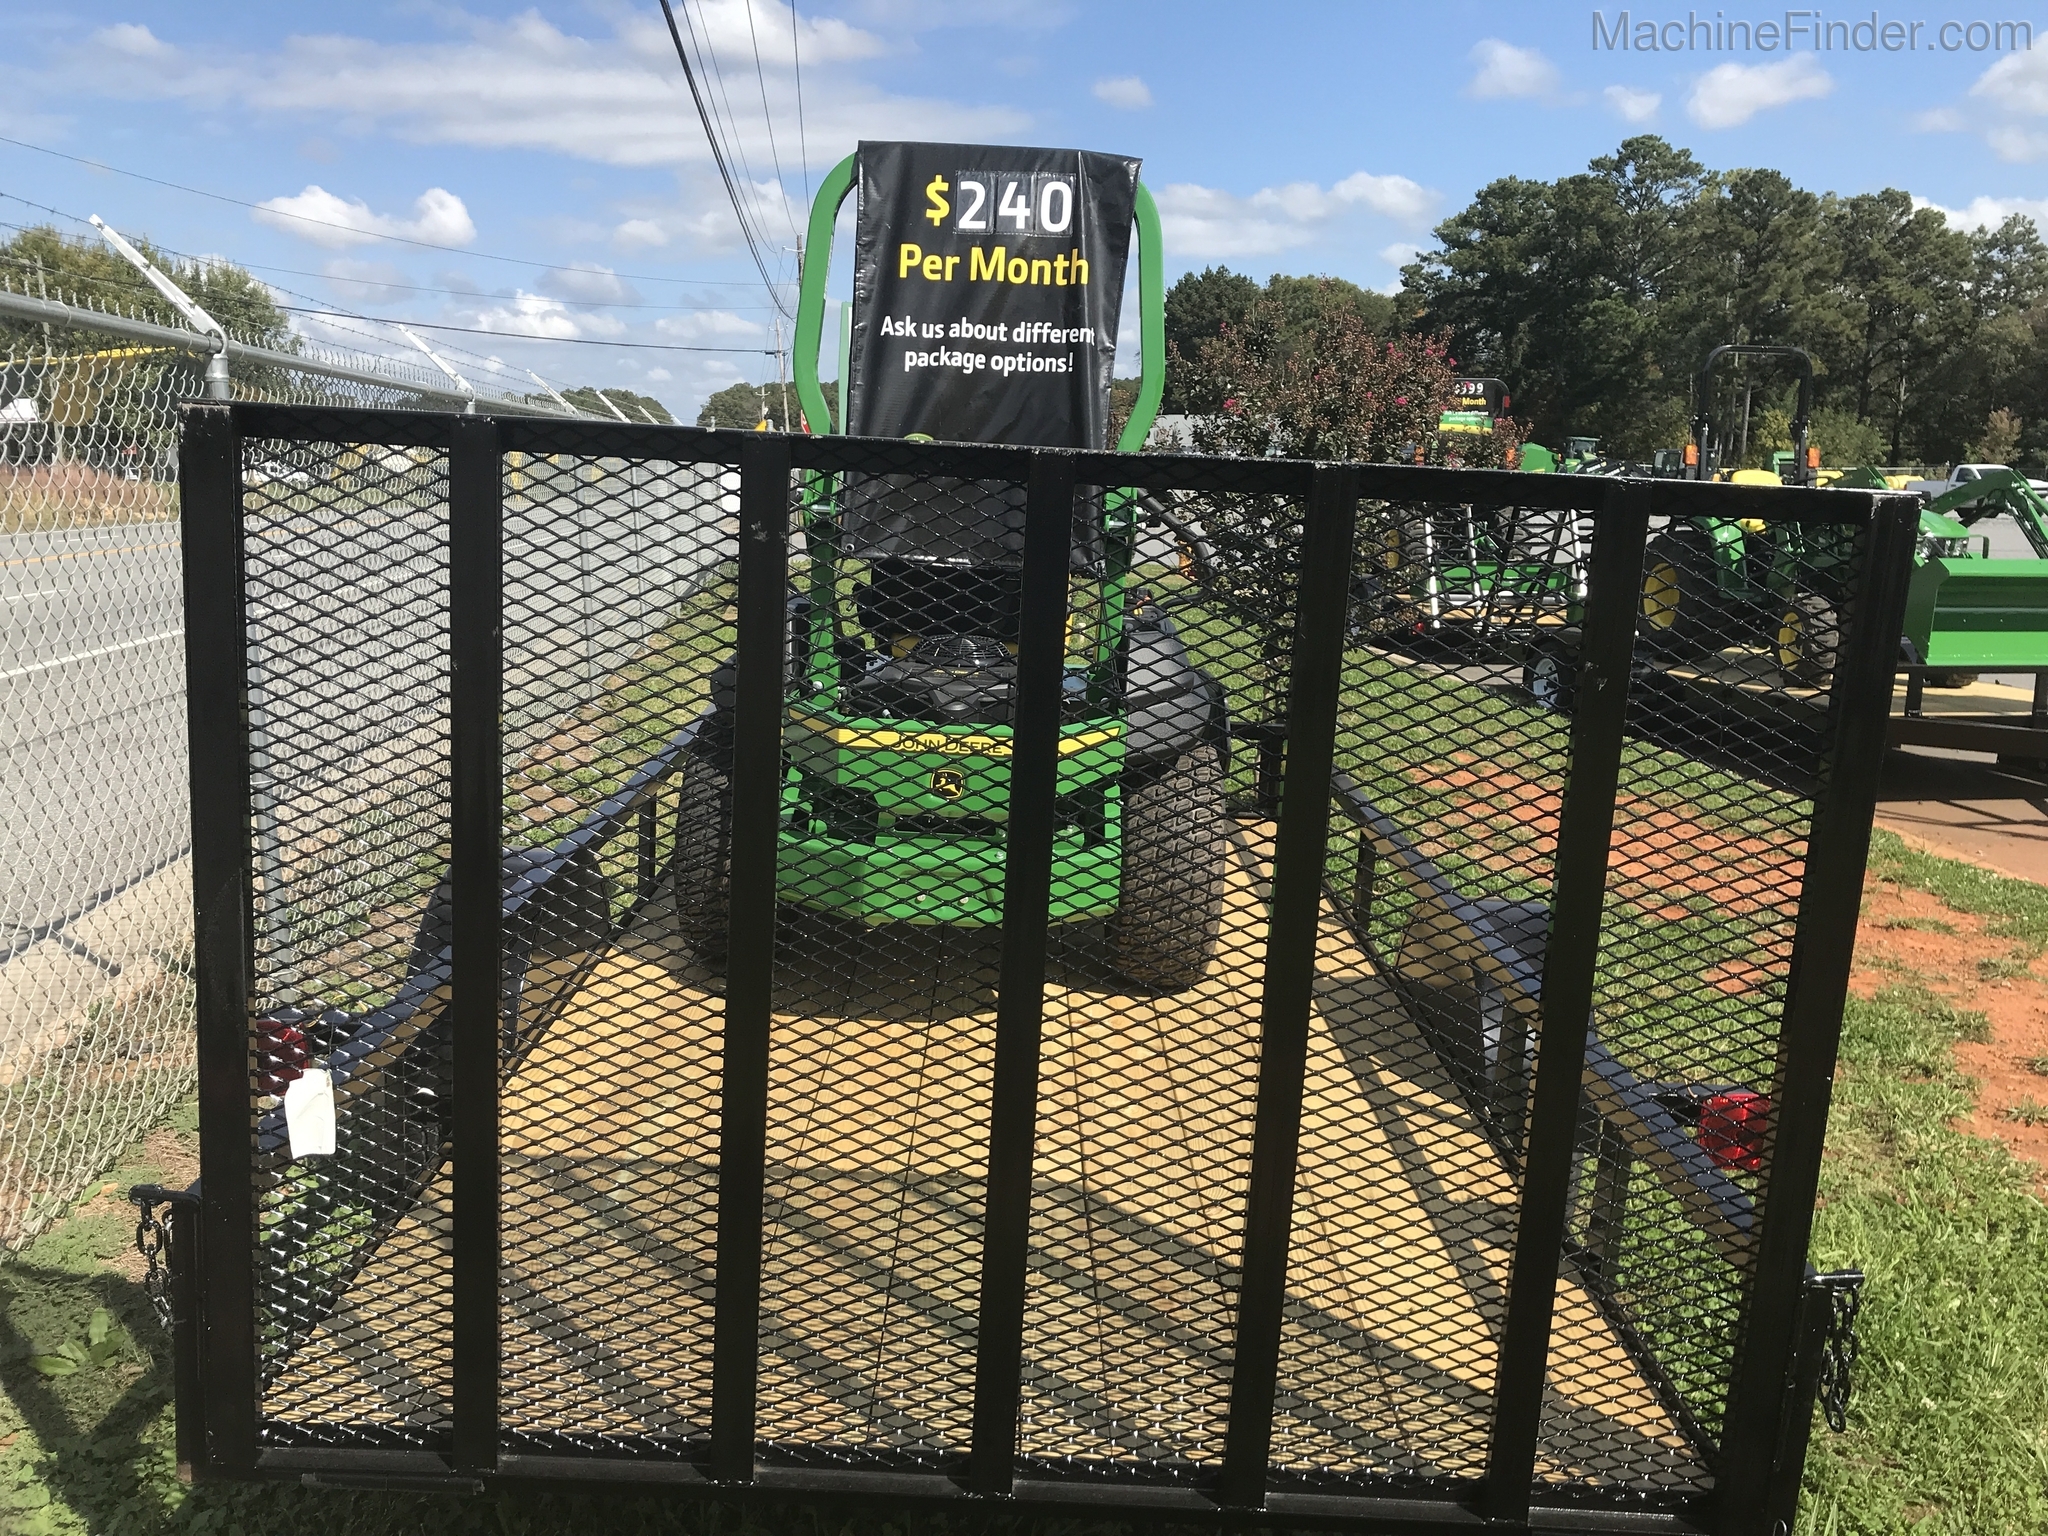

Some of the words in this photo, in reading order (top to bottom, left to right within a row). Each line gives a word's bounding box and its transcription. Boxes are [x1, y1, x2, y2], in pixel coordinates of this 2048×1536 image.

[925, 174, 1072, 232] $240
[899, 243, 960, 282] Per
[969, 246, 1089, 286] Month
[880, 314, 917, 338] Ask
[921, 321, 944, 339] us
[948, 316, 1008, 343] about
[904, 345, 986, 374] package
[991, 351, 1074, 377] options!
[1462, 397, 1487, 406] Month
